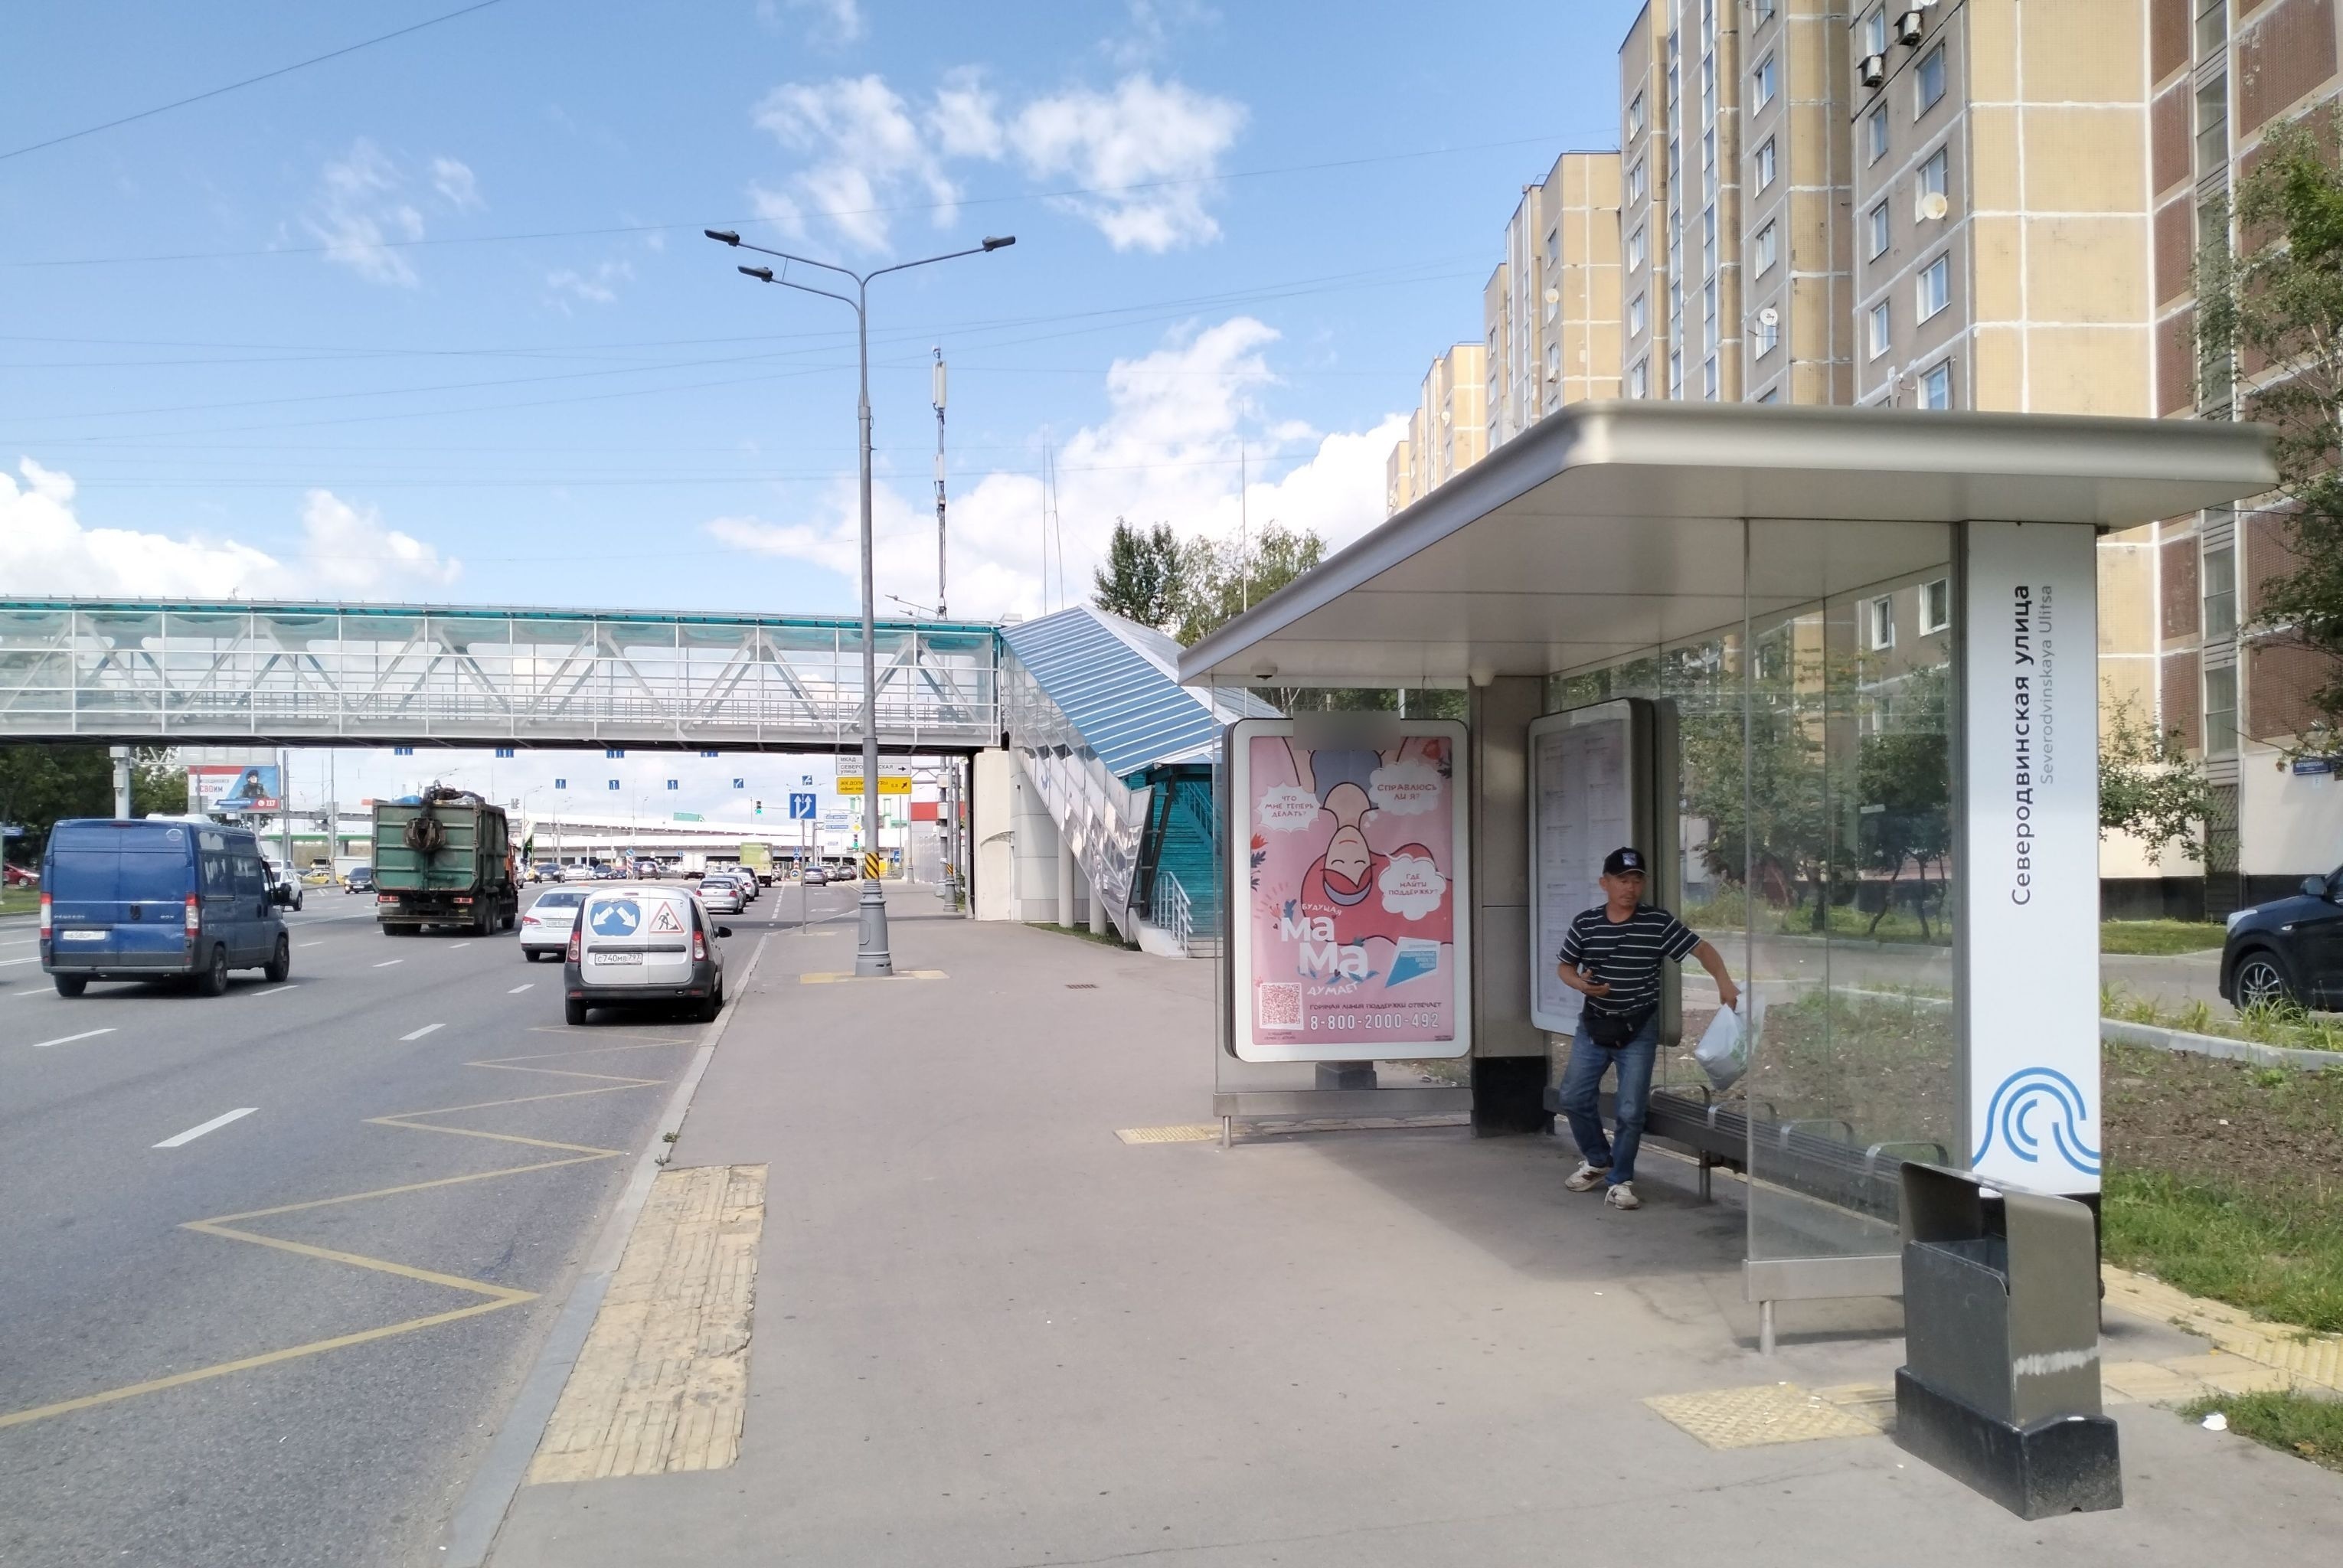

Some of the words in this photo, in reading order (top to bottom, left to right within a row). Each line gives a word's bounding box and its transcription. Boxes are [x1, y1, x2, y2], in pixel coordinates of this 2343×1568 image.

[2014, 586, 2034, 665] улица
[2038, 586, 2053, 633] Ulitsa
[2039, 640, 2056, 784] Severodvinskaya
[1377, 783, 1437, 792] СПРАВЛЮСЬ
[2012, 677, 2035, 906] Северодвинская
[1302, 903, 1342, 916] БУДУЩАЯ
[1307, 980, 1359, 996] ДУМАЕТ
[1309, 1012, 1439, 1031] 8-800-2000-492
